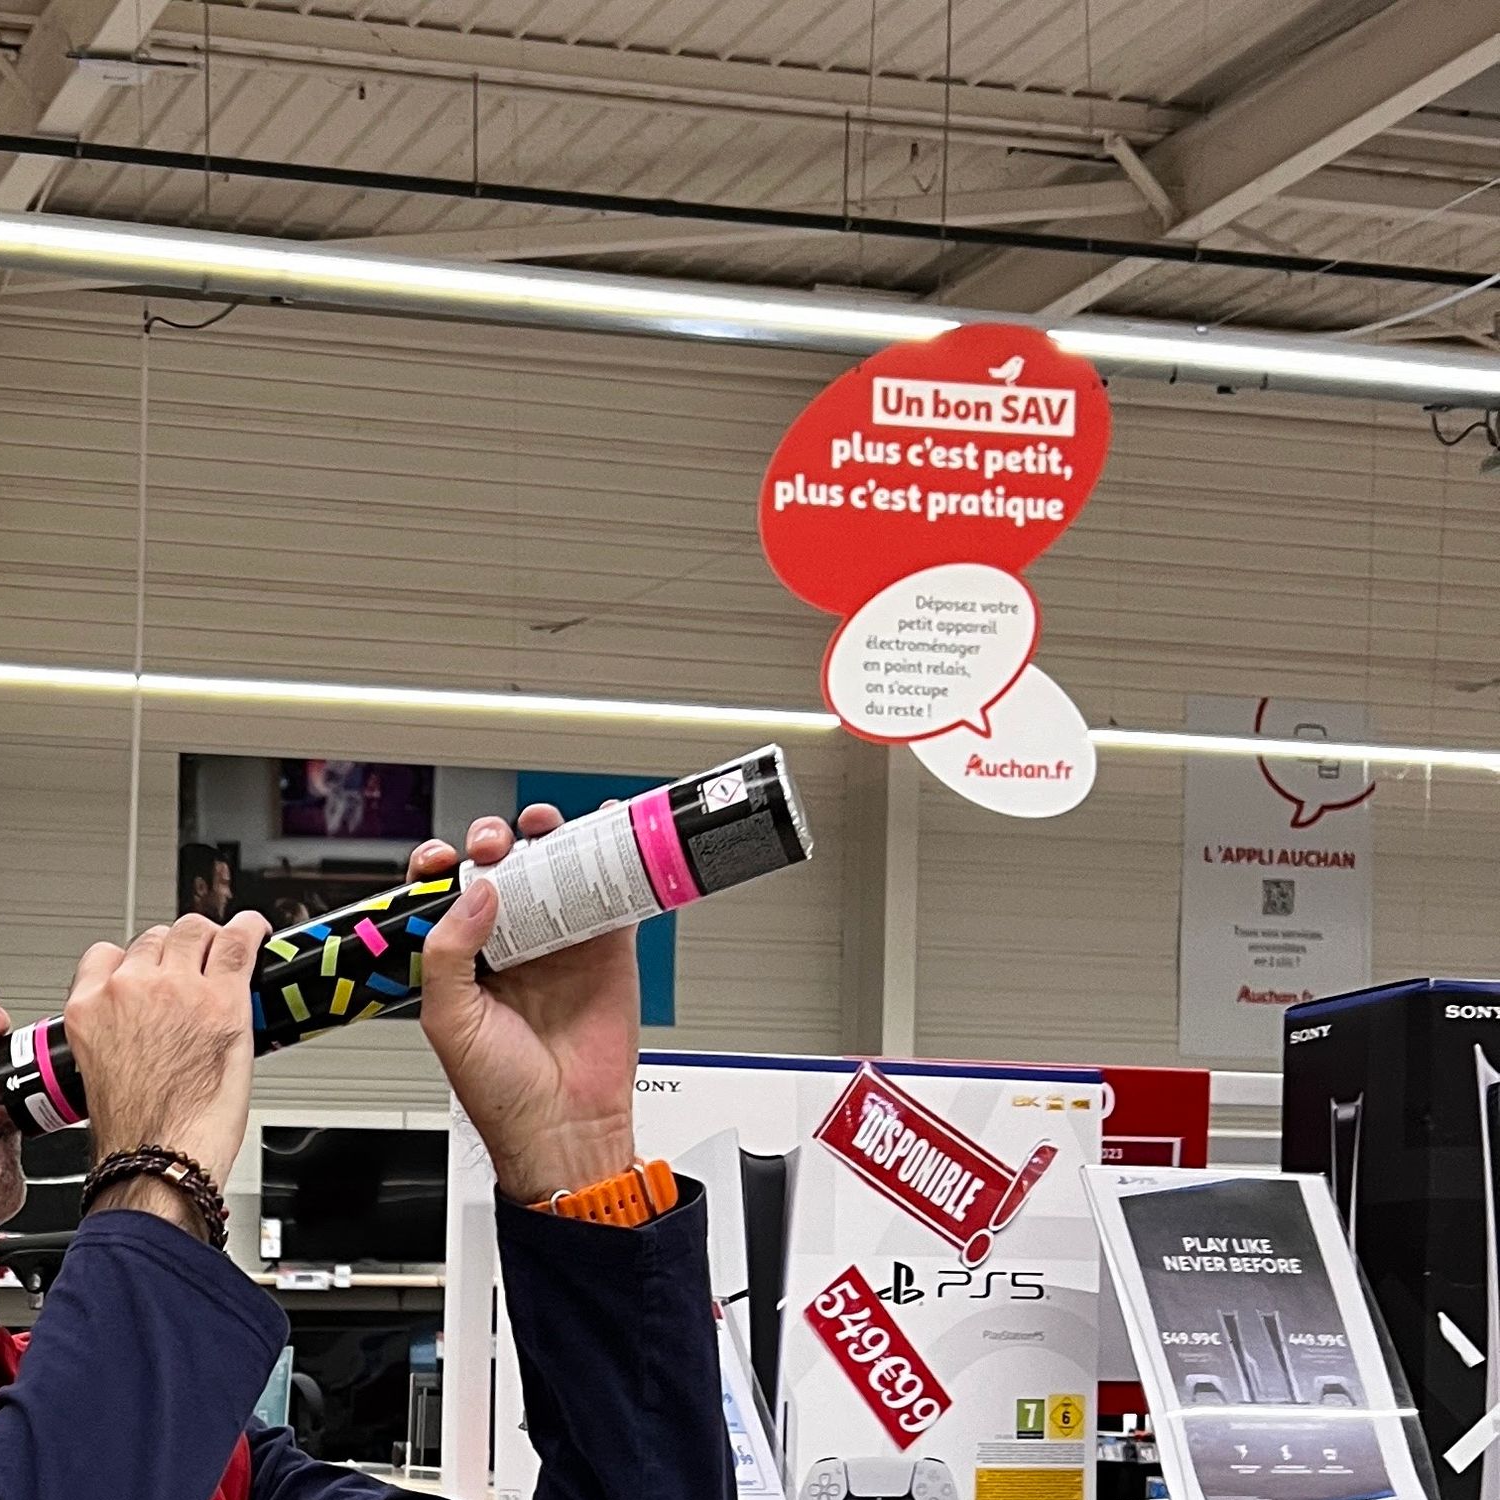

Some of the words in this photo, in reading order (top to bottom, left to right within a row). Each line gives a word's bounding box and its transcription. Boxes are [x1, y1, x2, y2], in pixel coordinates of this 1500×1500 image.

[882, 386, 923, 416] Un
[932, 390, 993, 422] bon
[1001, 395, 1068, 425] SAV
[831, 431, 901, 469] plus
[907, 437, 979, 470] c'est
[984, 443, 1073, 481] petit,
[774, 473, 844, 511] plus
[851, 479, 921, 513] c'est
[927, 486, 1064, 528] pratique
[915, 595, 977, 614] Déposez
[980, 602, 1019, 614] votre
[898, 617, 933, 633] petit
[936, 620, 998, 635] appareil
[866, 635, 981, 658] électroménager
[863, 661, 881, 671] en
[884, 658, 923, 675] point
[865, 683, 884, 694] on
[888, 681, 948, 699] s'occupe
[865, 701, 884, 715] du
[888, 705, 924, 717] reste
[964, 754, 1074, 780] Auchan.fr
[1277, 849, 1356, 869] AUCHAN
[1290, 1024, 1332, 1044] SONY
[636, 1080, 682, 1092] ONY
[1182, 1237, 1229, 1253] PLAY
[1231, 1238, 1273, 1254] LIKE
[1163, 1255, 1228, 1272] NEVER
[1229, 1257, 1302, 1274] BEFORE
[937, 1270, 1044, 1300] PS5
[815, 1280, 943, 1434] 549€99
[1024, 1403, 1037, 1428] 7
[1062, 1411, 1071, 1424] 6
